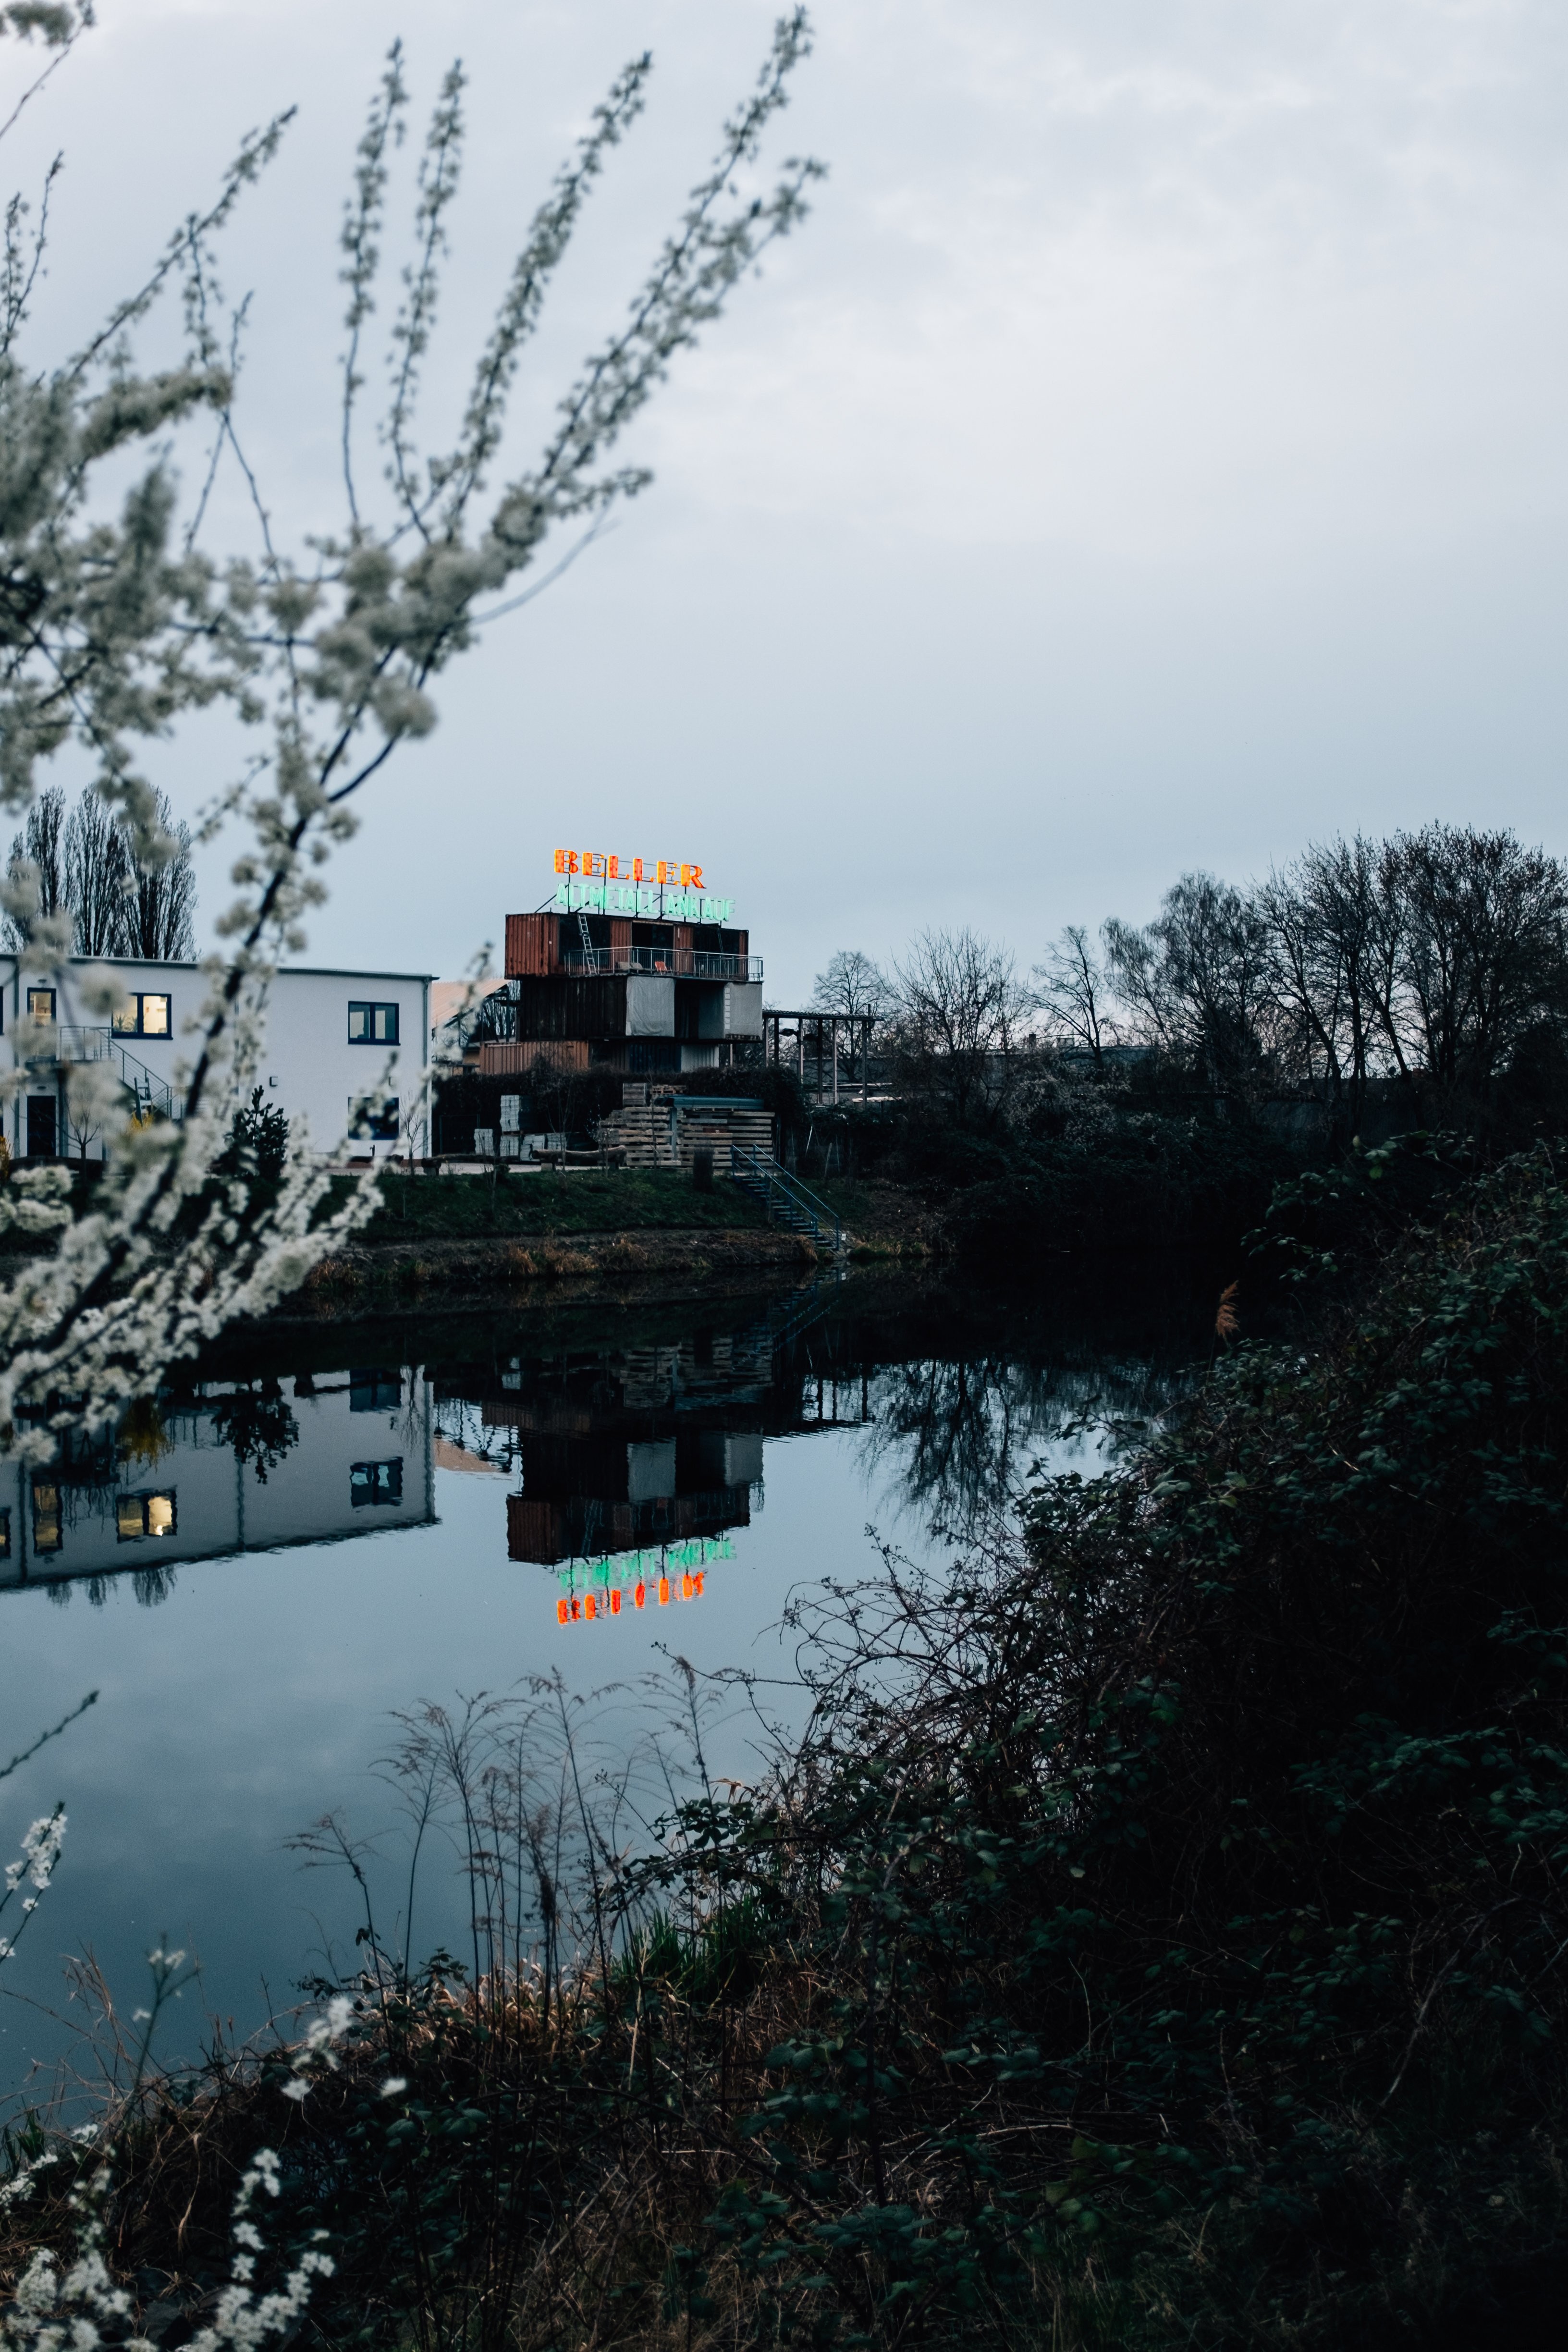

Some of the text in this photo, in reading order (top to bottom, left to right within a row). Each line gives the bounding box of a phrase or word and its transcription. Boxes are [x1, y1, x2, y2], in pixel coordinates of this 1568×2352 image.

[554, 849, 706, 889] BELLER
[554, 883, 735, 921] ALTMETALL ANKAUF
